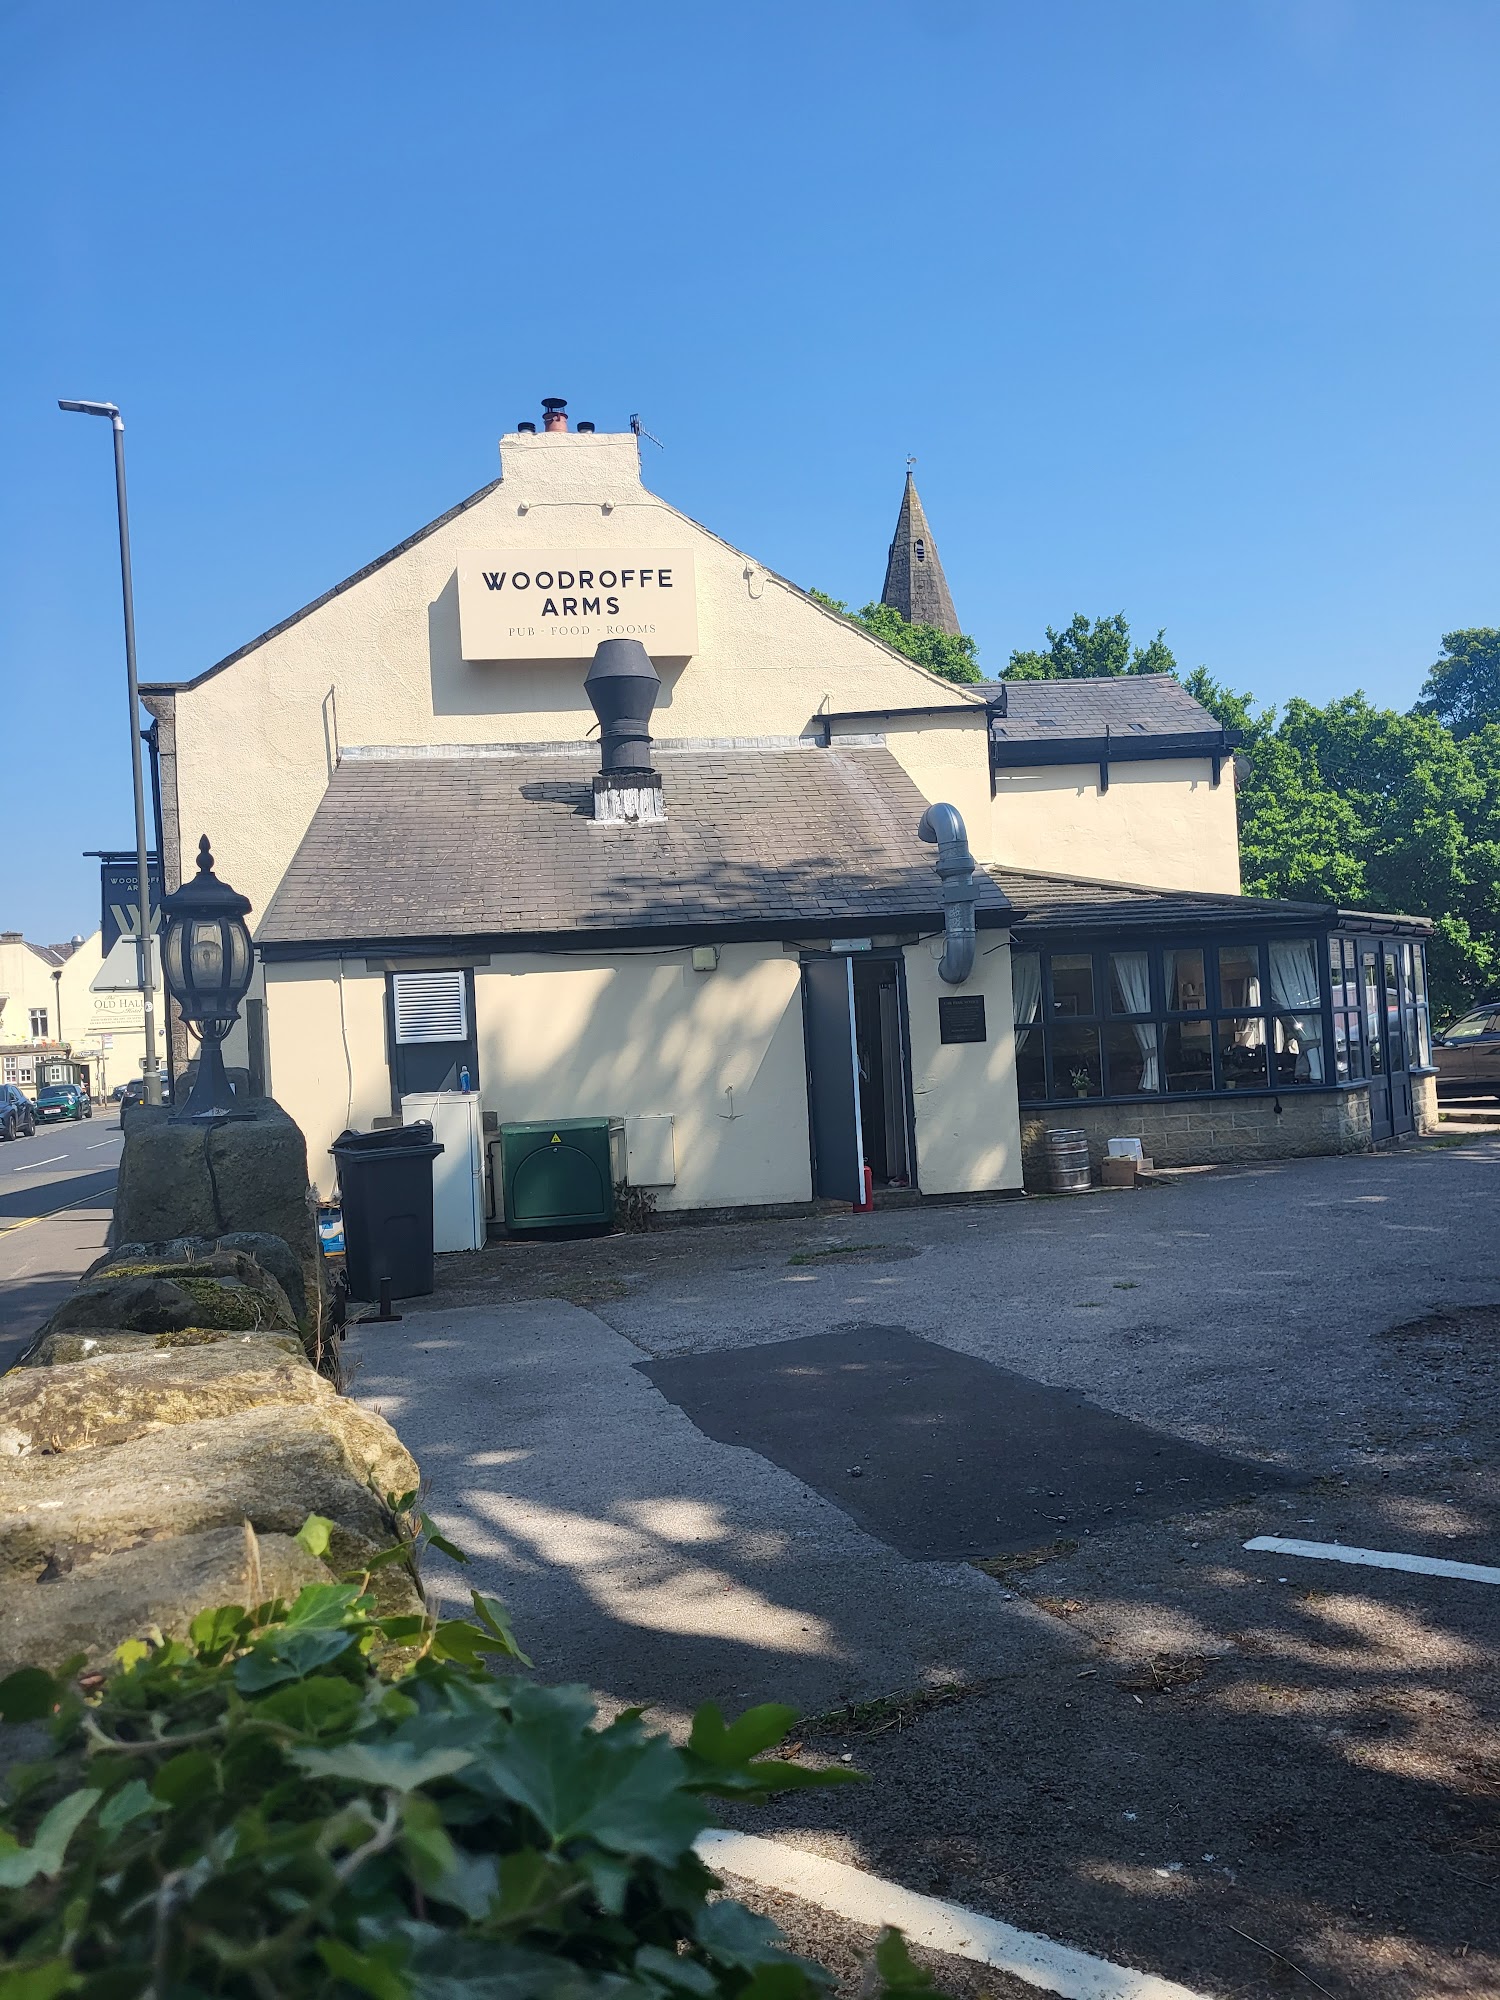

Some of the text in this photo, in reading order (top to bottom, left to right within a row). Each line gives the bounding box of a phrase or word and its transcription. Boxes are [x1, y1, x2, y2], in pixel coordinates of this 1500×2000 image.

[481, 569, 673, 591] WOODROFFE
[541, 596, 620, 617] ARMS
[508, 624, 657, 637] PUB FOOD ROOMS
[94, 999, 116, 1009] OLD
